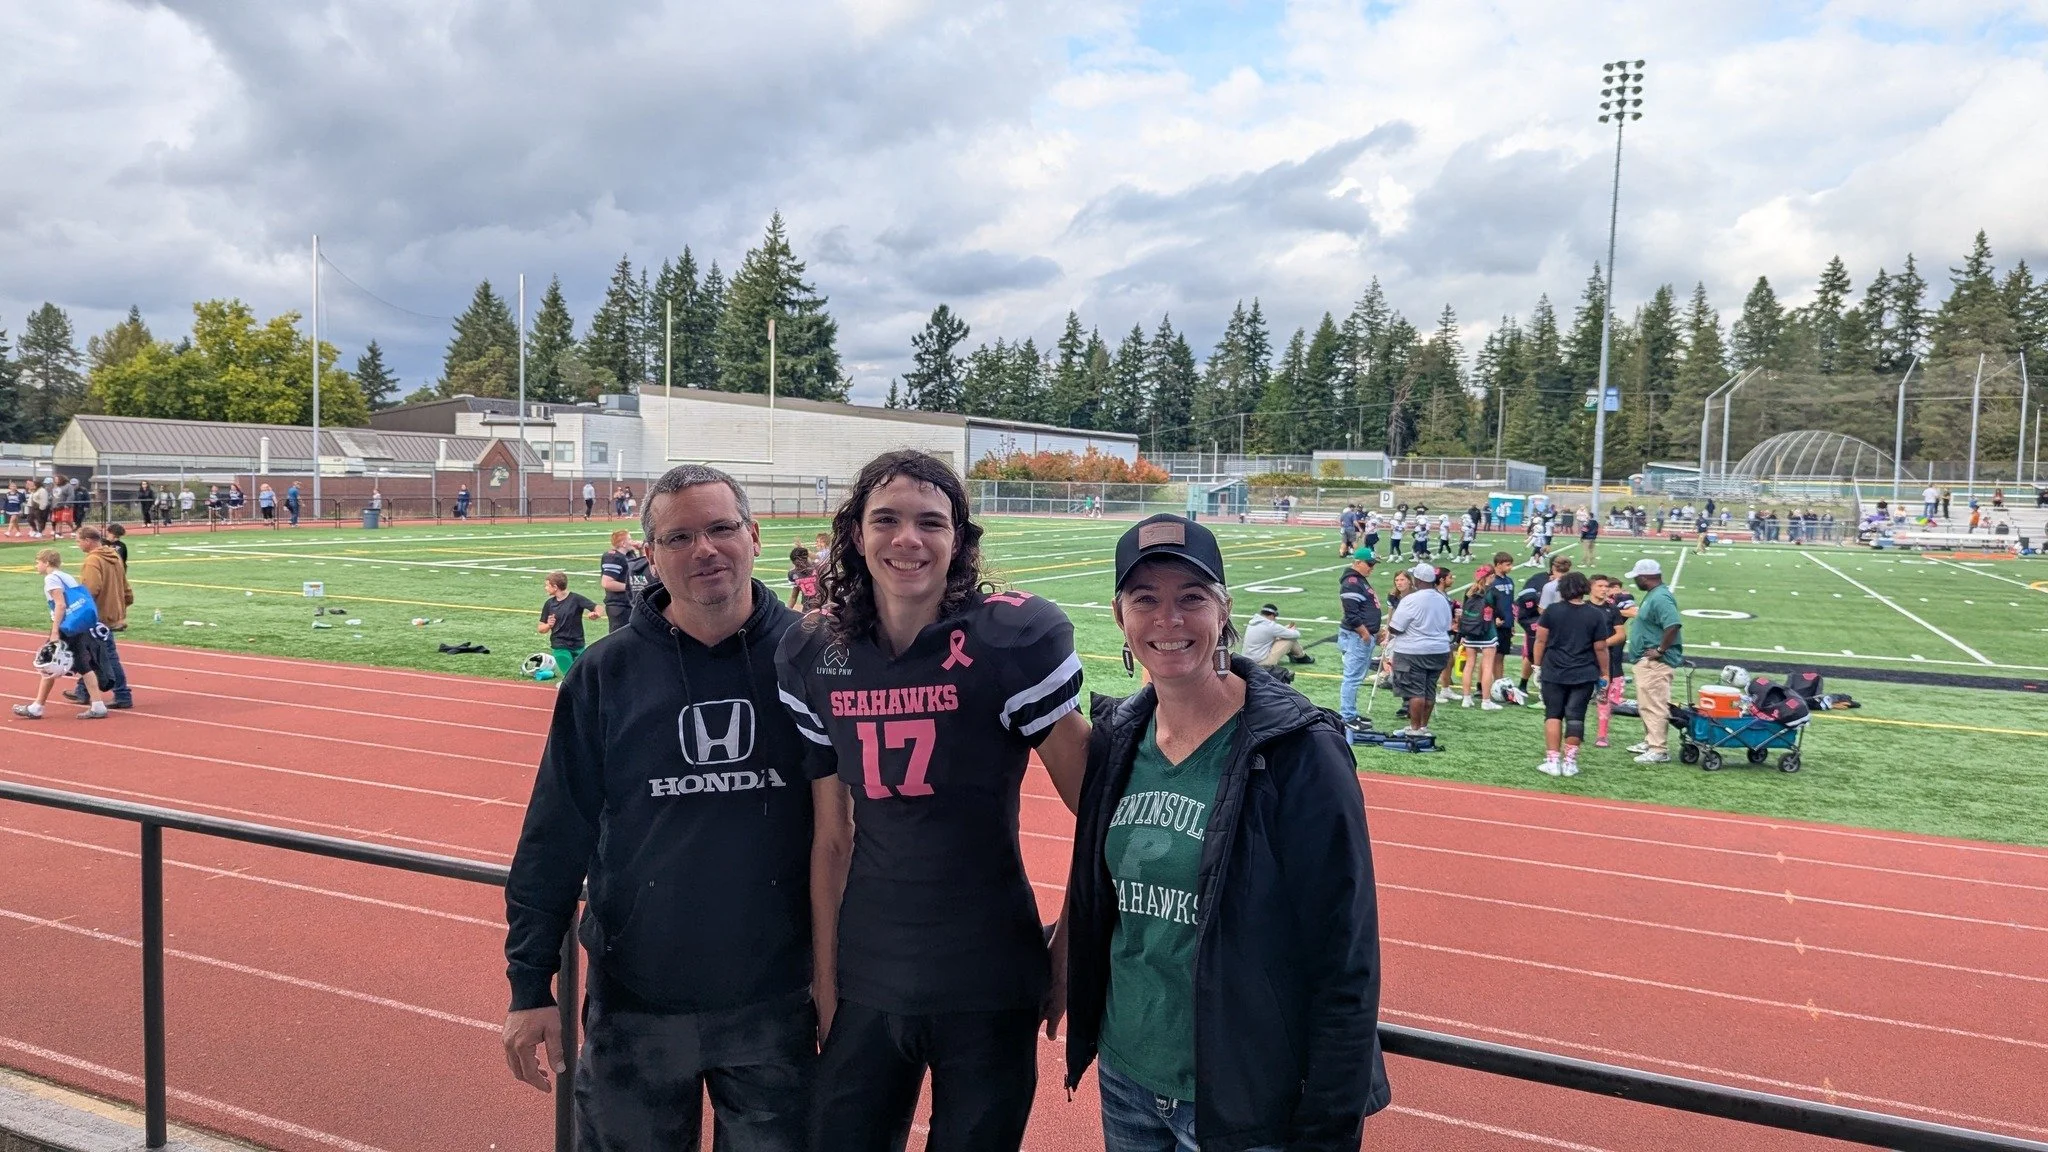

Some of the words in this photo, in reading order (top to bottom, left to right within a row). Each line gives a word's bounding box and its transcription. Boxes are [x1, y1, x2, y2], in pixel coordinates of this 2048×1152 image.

[818, 479, 824, 490] C
[1383, 492, 1390, 502] D
[816, 666, 837, 676] LIVING
[838, 667, 853, 676] PNW
[830, 684, 959, 717] SEAHAWKS
[856, 718, 937, 800] 17
[648, 768, 787, 797] HONDA
[1108, 791, 1206, 842] ENINSUL
[1117, 826, 1173, 880] P
[1111, 878, 1199, 926] AHAWK
